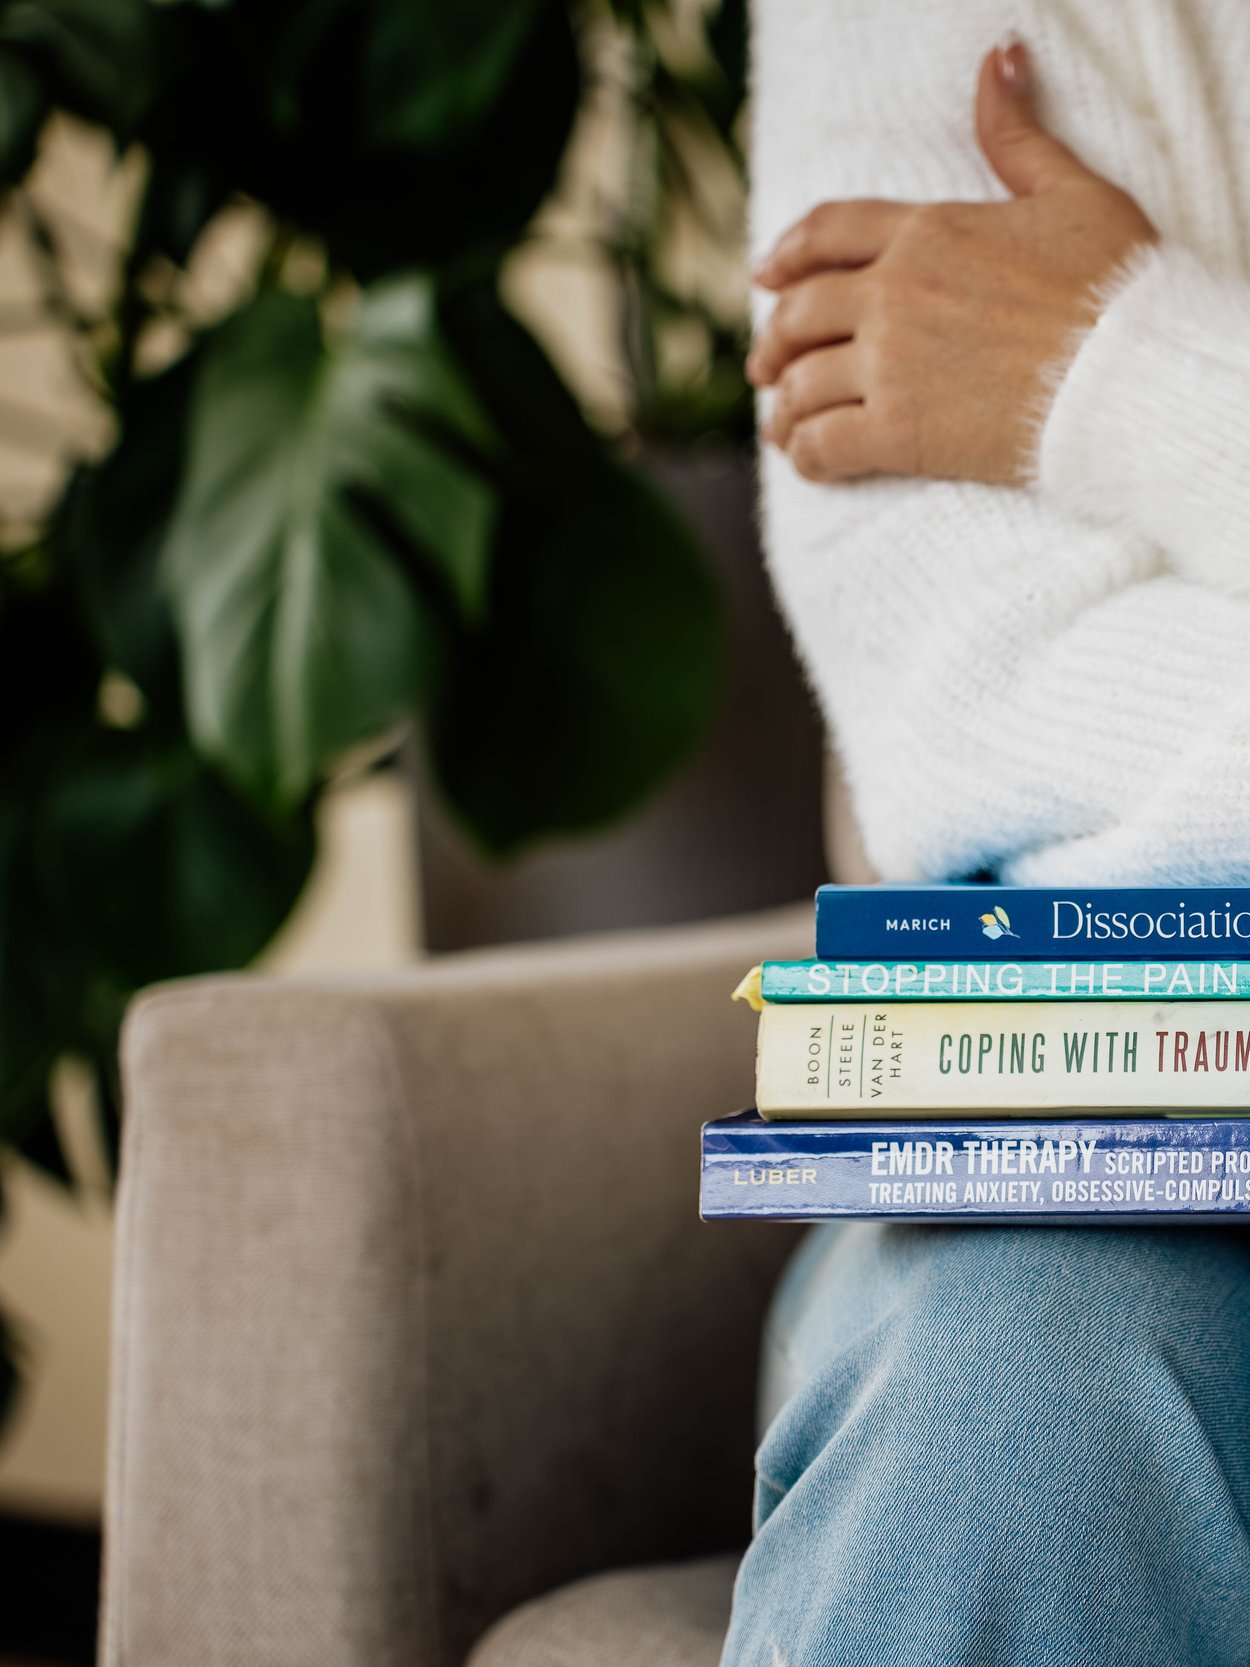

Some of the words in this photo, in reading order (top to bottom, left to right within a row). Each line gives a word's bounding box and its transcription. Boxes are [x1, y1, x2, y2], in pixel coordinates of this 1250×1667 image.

[886, 918, 950, 931] MARICH
[807, 963, 1023, 995] STOPPING
[1043, 963, 1123, 994] THE
[1143, 962, 1237, 994] PAIN
[872, 1014, 887, 1046] DER
[807, 1027, 822, 1084] BOON
[839, 1024, 854, 1086] STEELE
[890, 1031, 903, 1078] HART
[938, 1031, 1046, 1075] COPING
[1062, 1030, 1138, 1074] WITH
[871, 1059, 883, 1098] VAN
[870, 1141, 955, 1176] EMDR
[963, 1140, 1098, 1175] THERAPY
[1105, 1151, 1205, 1174] SCRIPTED
[733, 1168, 818, 1185] LUBER
[869, 1182, 958, 1205] TREATING
[963, 1180, 1045, 1206] ANXIETY,
